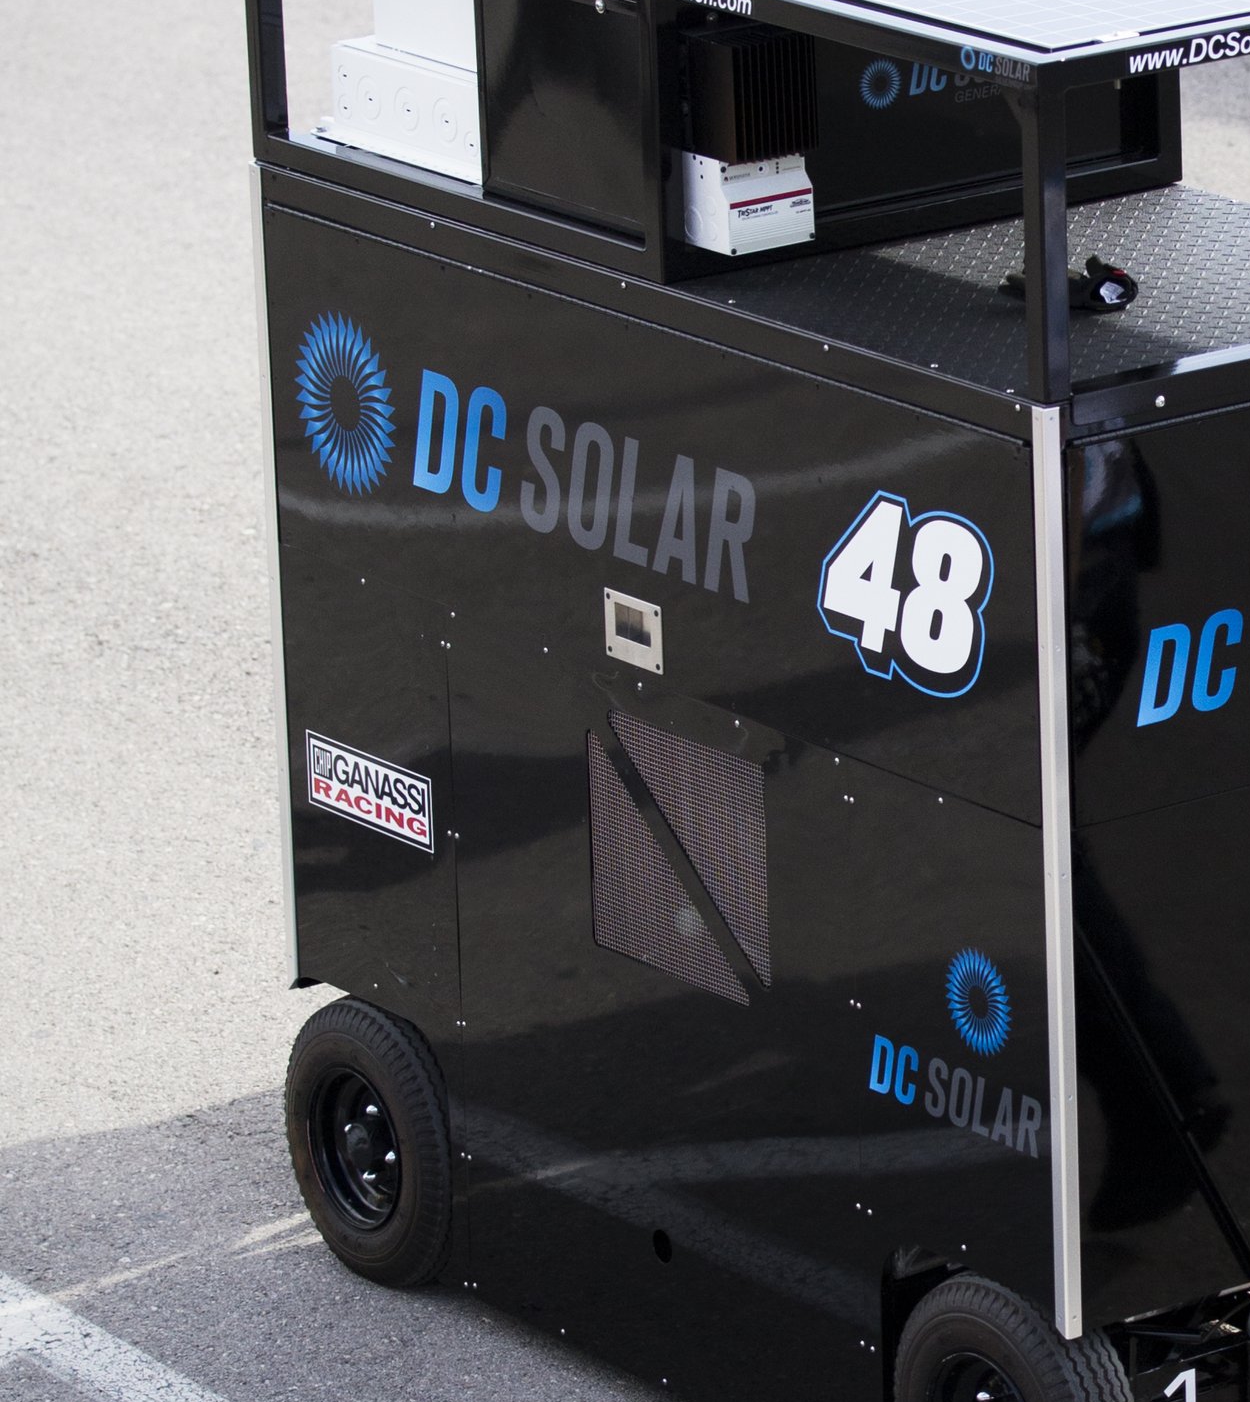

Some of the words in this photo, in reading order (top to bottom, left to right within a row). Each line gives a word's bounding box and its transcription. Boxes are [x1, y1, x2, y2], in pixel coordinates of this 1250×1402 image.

[978, 52, 994, 74] DC
[995, 56, 1031, 83] SOLAR
[413, 369, 507, 512] DC
[519, 405, 757, 603] SOLAR
[820, 497, 988, 677] 48
[1136, 608, 1243, 727] DC
[314, 777, 427, 838] RACING
[333, 754, 426, 818] GANASSI
[869, 1034, 920, 1106] DC
[924, 1057, 1043, 1159] SOLAR
